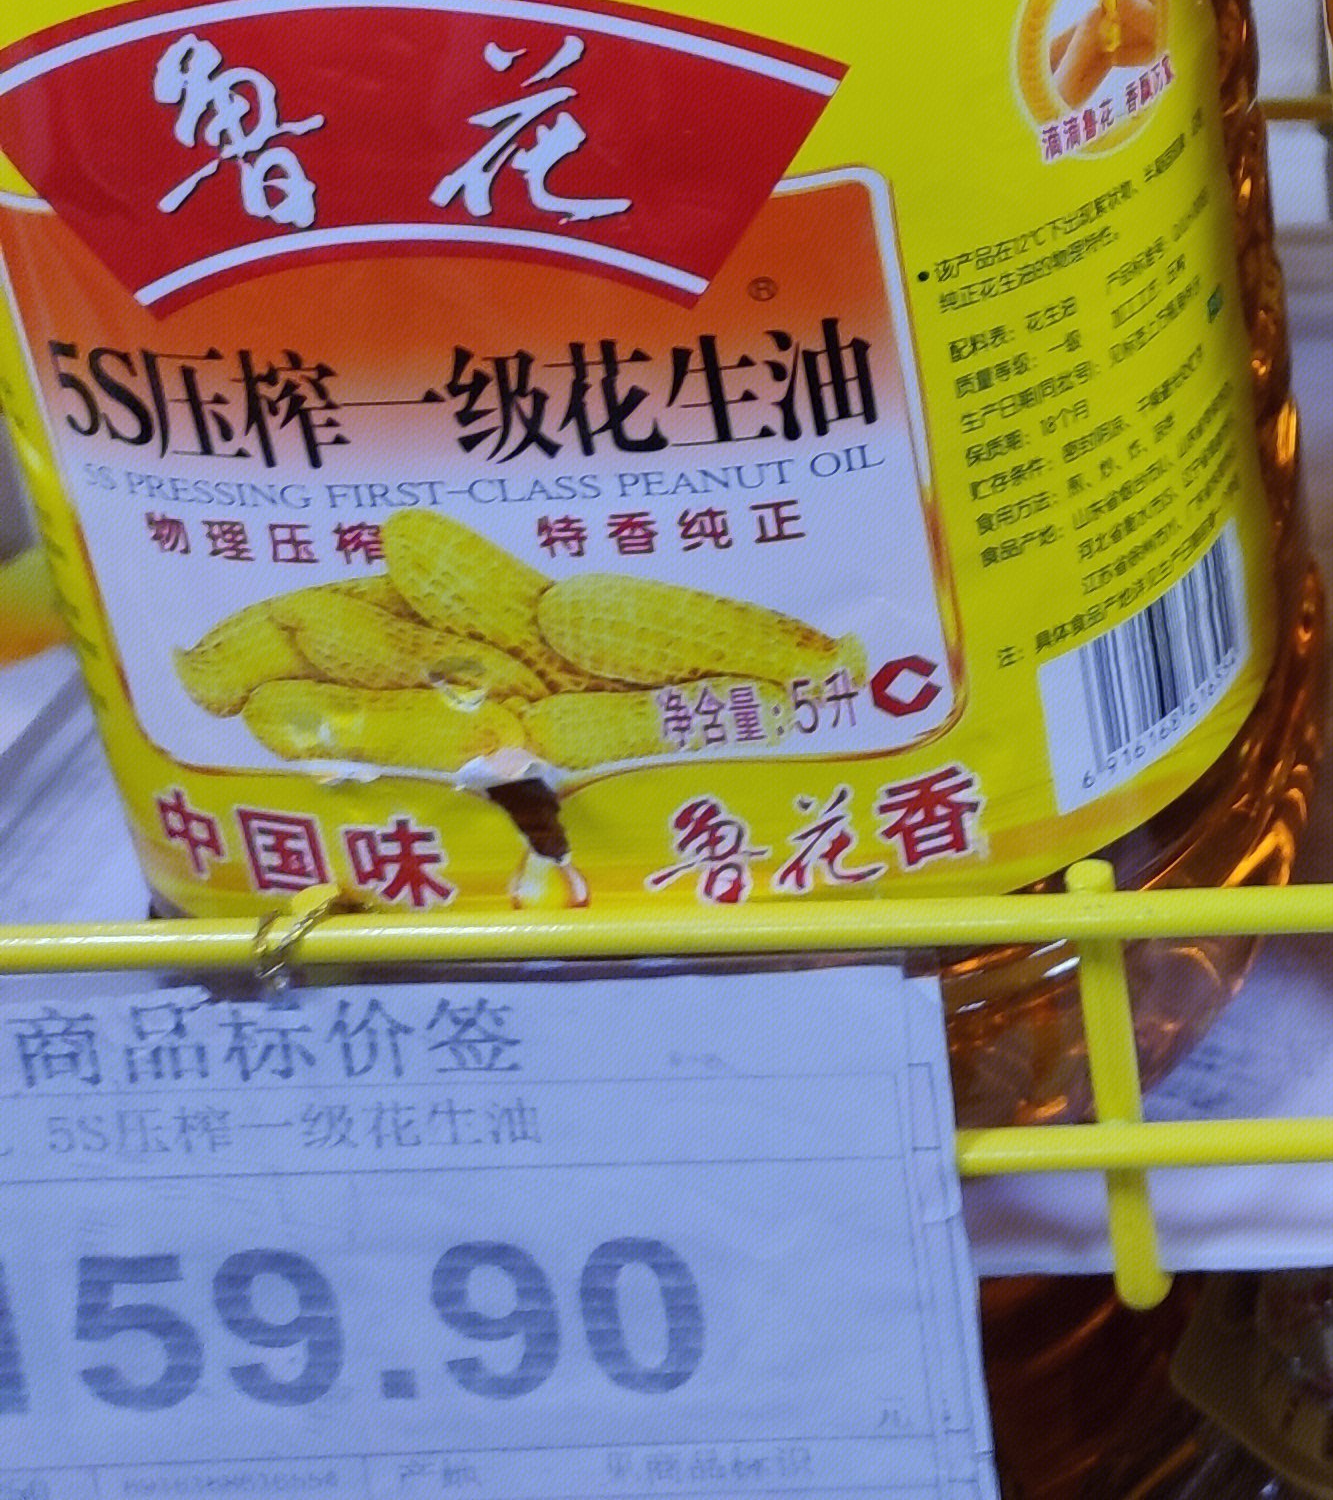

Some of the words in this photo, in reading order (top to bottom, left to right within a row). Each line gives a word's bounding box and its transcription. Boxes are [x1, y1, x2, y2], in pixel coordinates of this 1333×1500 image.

[152, 33, 632, 227] 鲁花
[48, 317, 878, 469] 5S压榨一级花生油
[125, 471, 313, 511] PRESSING
[326, 472, 602, 511] FIRST-CLASS
[616, 457, 794, 500] PEANUT
[808, 443, 886, 479] OIL
[146, 511, 387, 566] 物理压榨
[536, 501, 805, 561] 特香纯正
[156, 789, 456, 908] 中国味
[650, 765, 982, 906] 鲁花香
[7, 997, 522, 1088] 商品标价签
[45, 1097, 542, 1154] 5S压榨一级花生油
